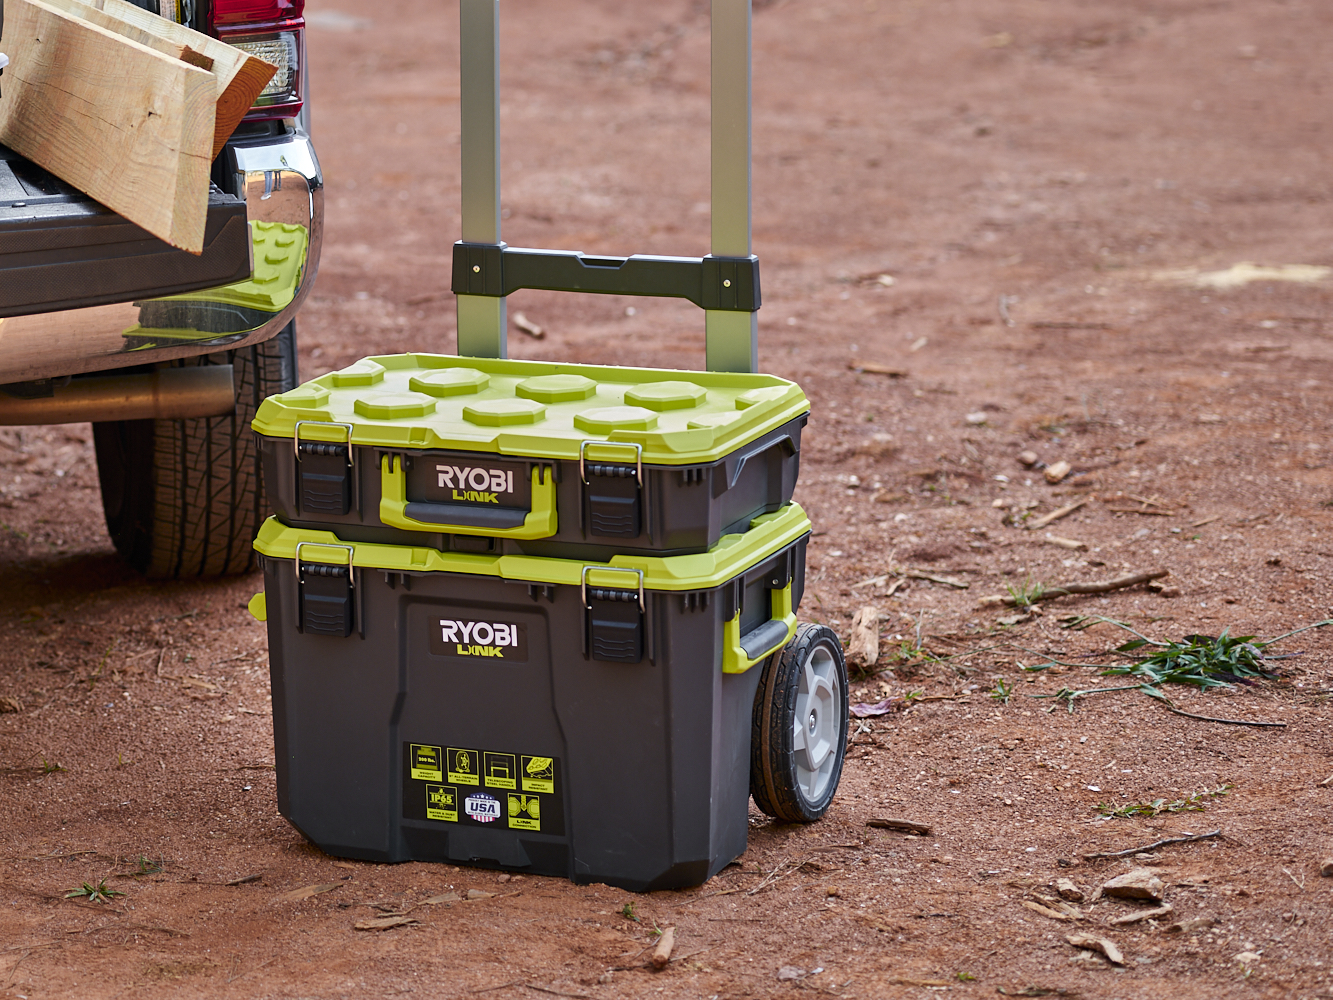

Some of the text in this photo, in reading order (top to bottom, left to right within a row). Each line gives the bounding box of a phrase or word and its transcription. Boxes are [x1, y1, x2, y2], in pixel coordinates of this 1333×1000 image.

[435, 464, 514, 493] RYOBI
[439, 619, 518, 647] RYOBI
[430, 793, 453, 804] IP65
[470, 802, 496, 813] USA
